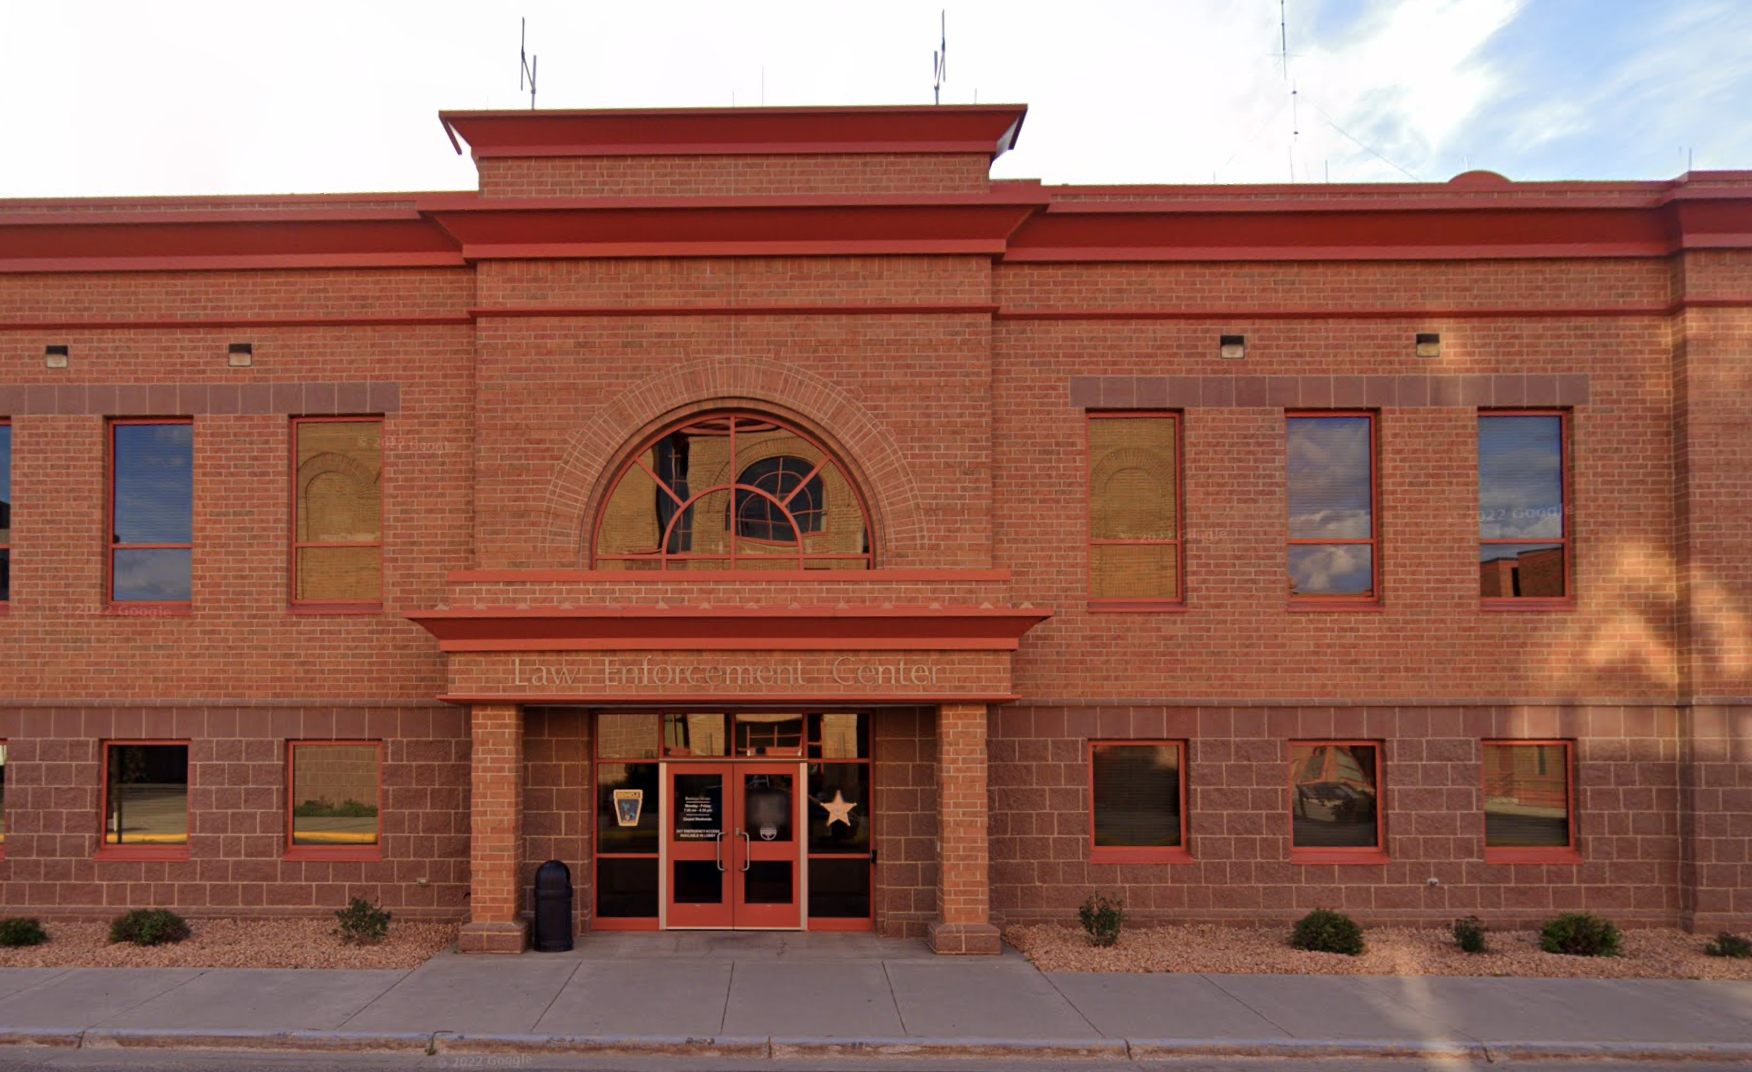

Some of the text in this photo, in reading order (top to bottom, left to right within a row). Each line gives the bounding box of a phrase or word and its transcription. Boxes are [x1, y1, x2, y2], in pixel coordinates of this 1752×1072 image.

[513, 656, 941, 686] Law Enforcement Center
